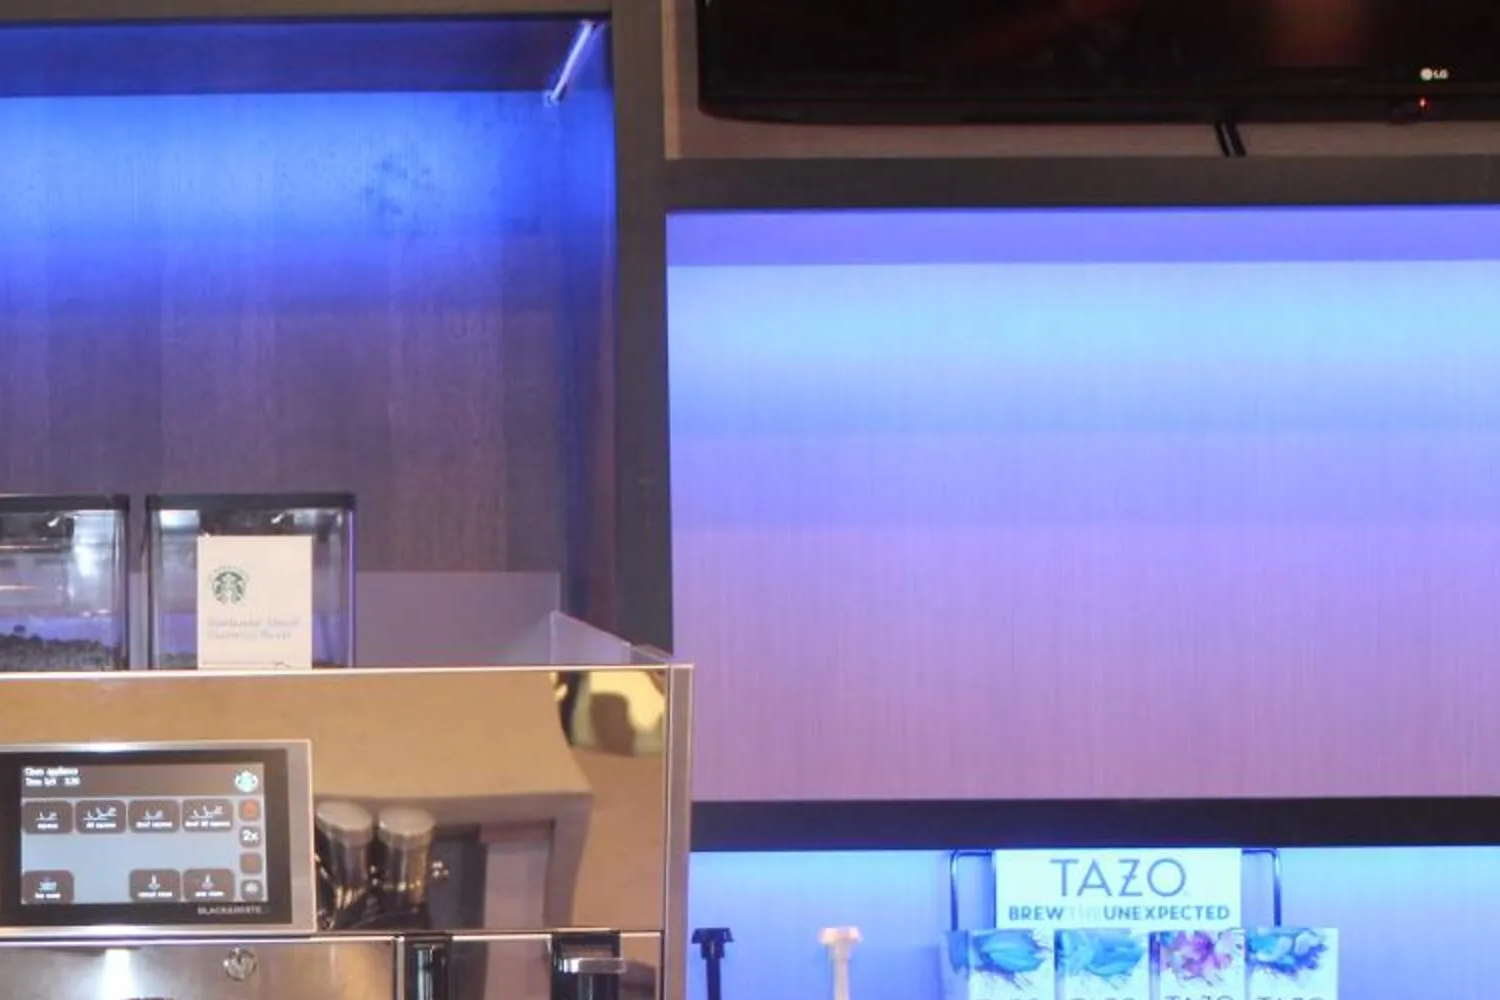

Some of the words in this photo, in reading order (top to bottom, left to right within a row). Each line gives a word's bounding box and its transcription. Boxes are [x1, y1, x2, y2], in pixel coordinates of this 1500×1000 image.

[1049, 857, 1187, 898] TAZO
[1008, 905, 1065, 921] BREW
[1103, 905, 1231, 921] UNEXPECTED
